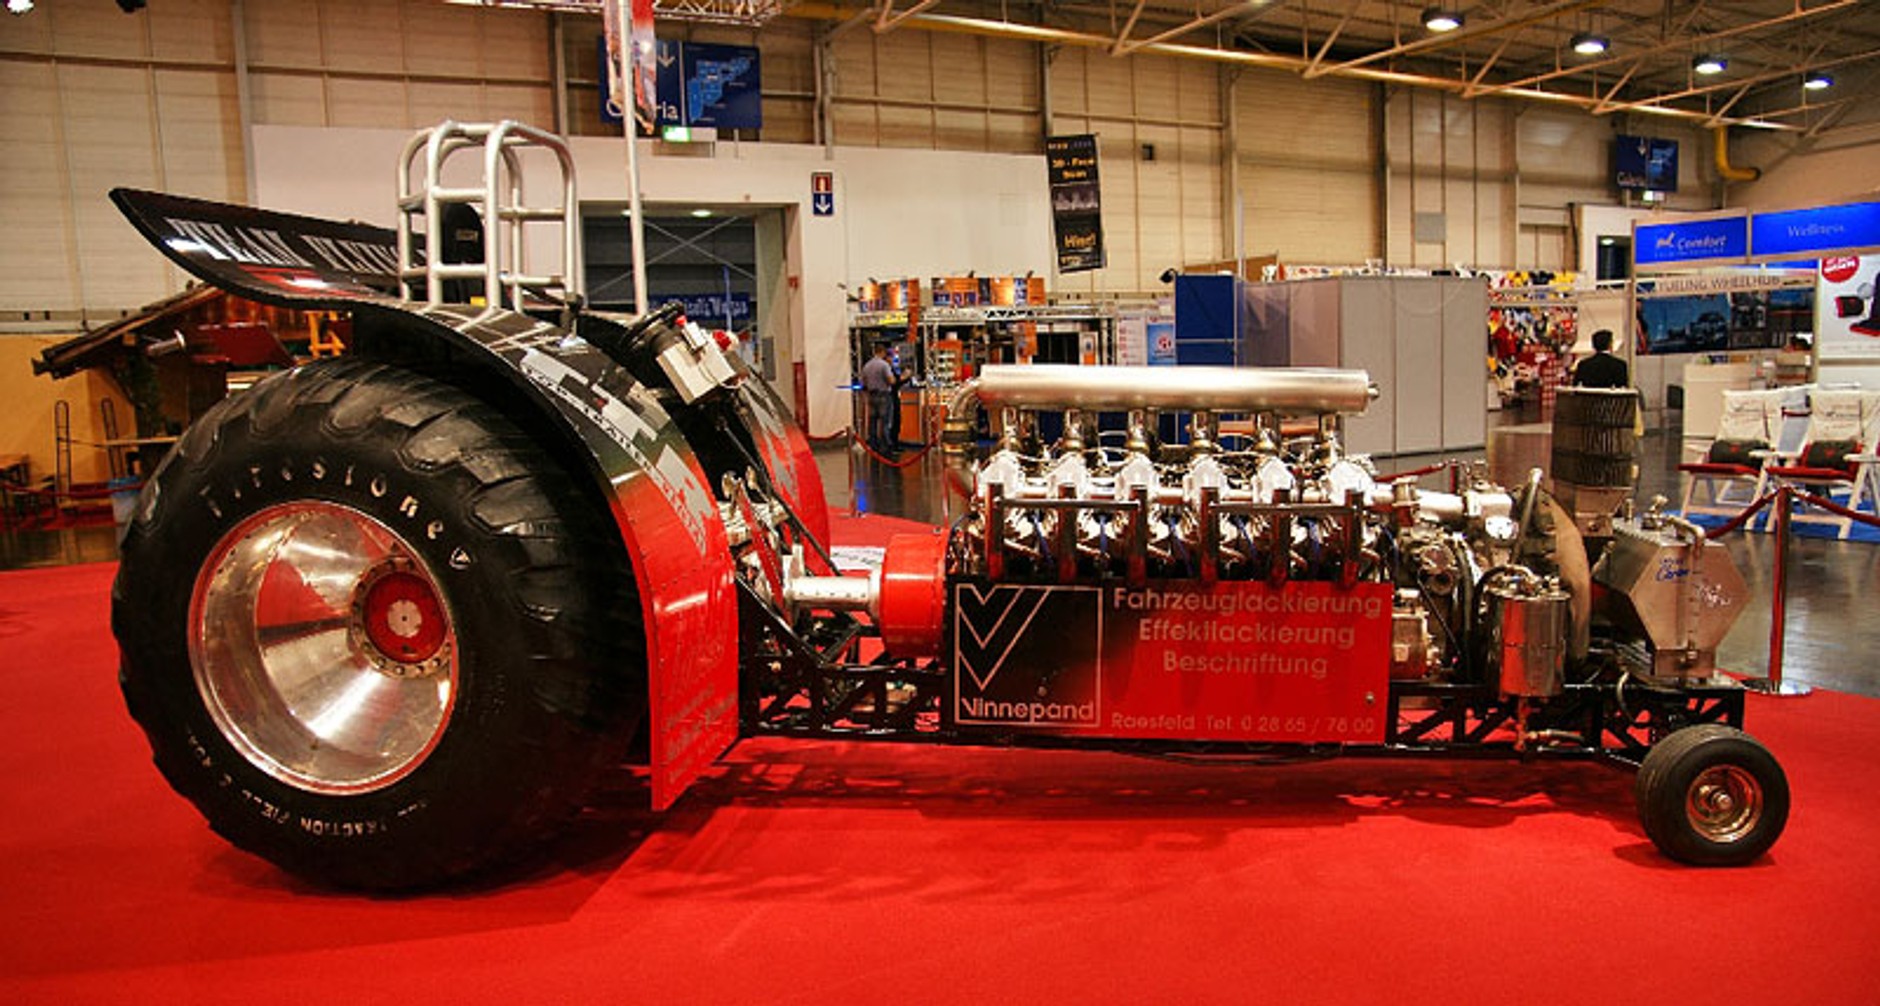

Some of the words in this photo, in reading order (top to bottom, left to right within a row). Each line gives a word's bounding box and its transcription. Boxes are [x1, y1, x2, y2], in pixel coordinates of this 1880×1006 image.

[163, 217, 314, 267] TEAM
[1113, 587, 1382, 619] Fahrzeuglackierung
[1163, 649, 1328, 679] Beschriftung
[961, 697, 1094, 723] Vinnepand
[1111, 711, 1195, 730] Raesfeld
